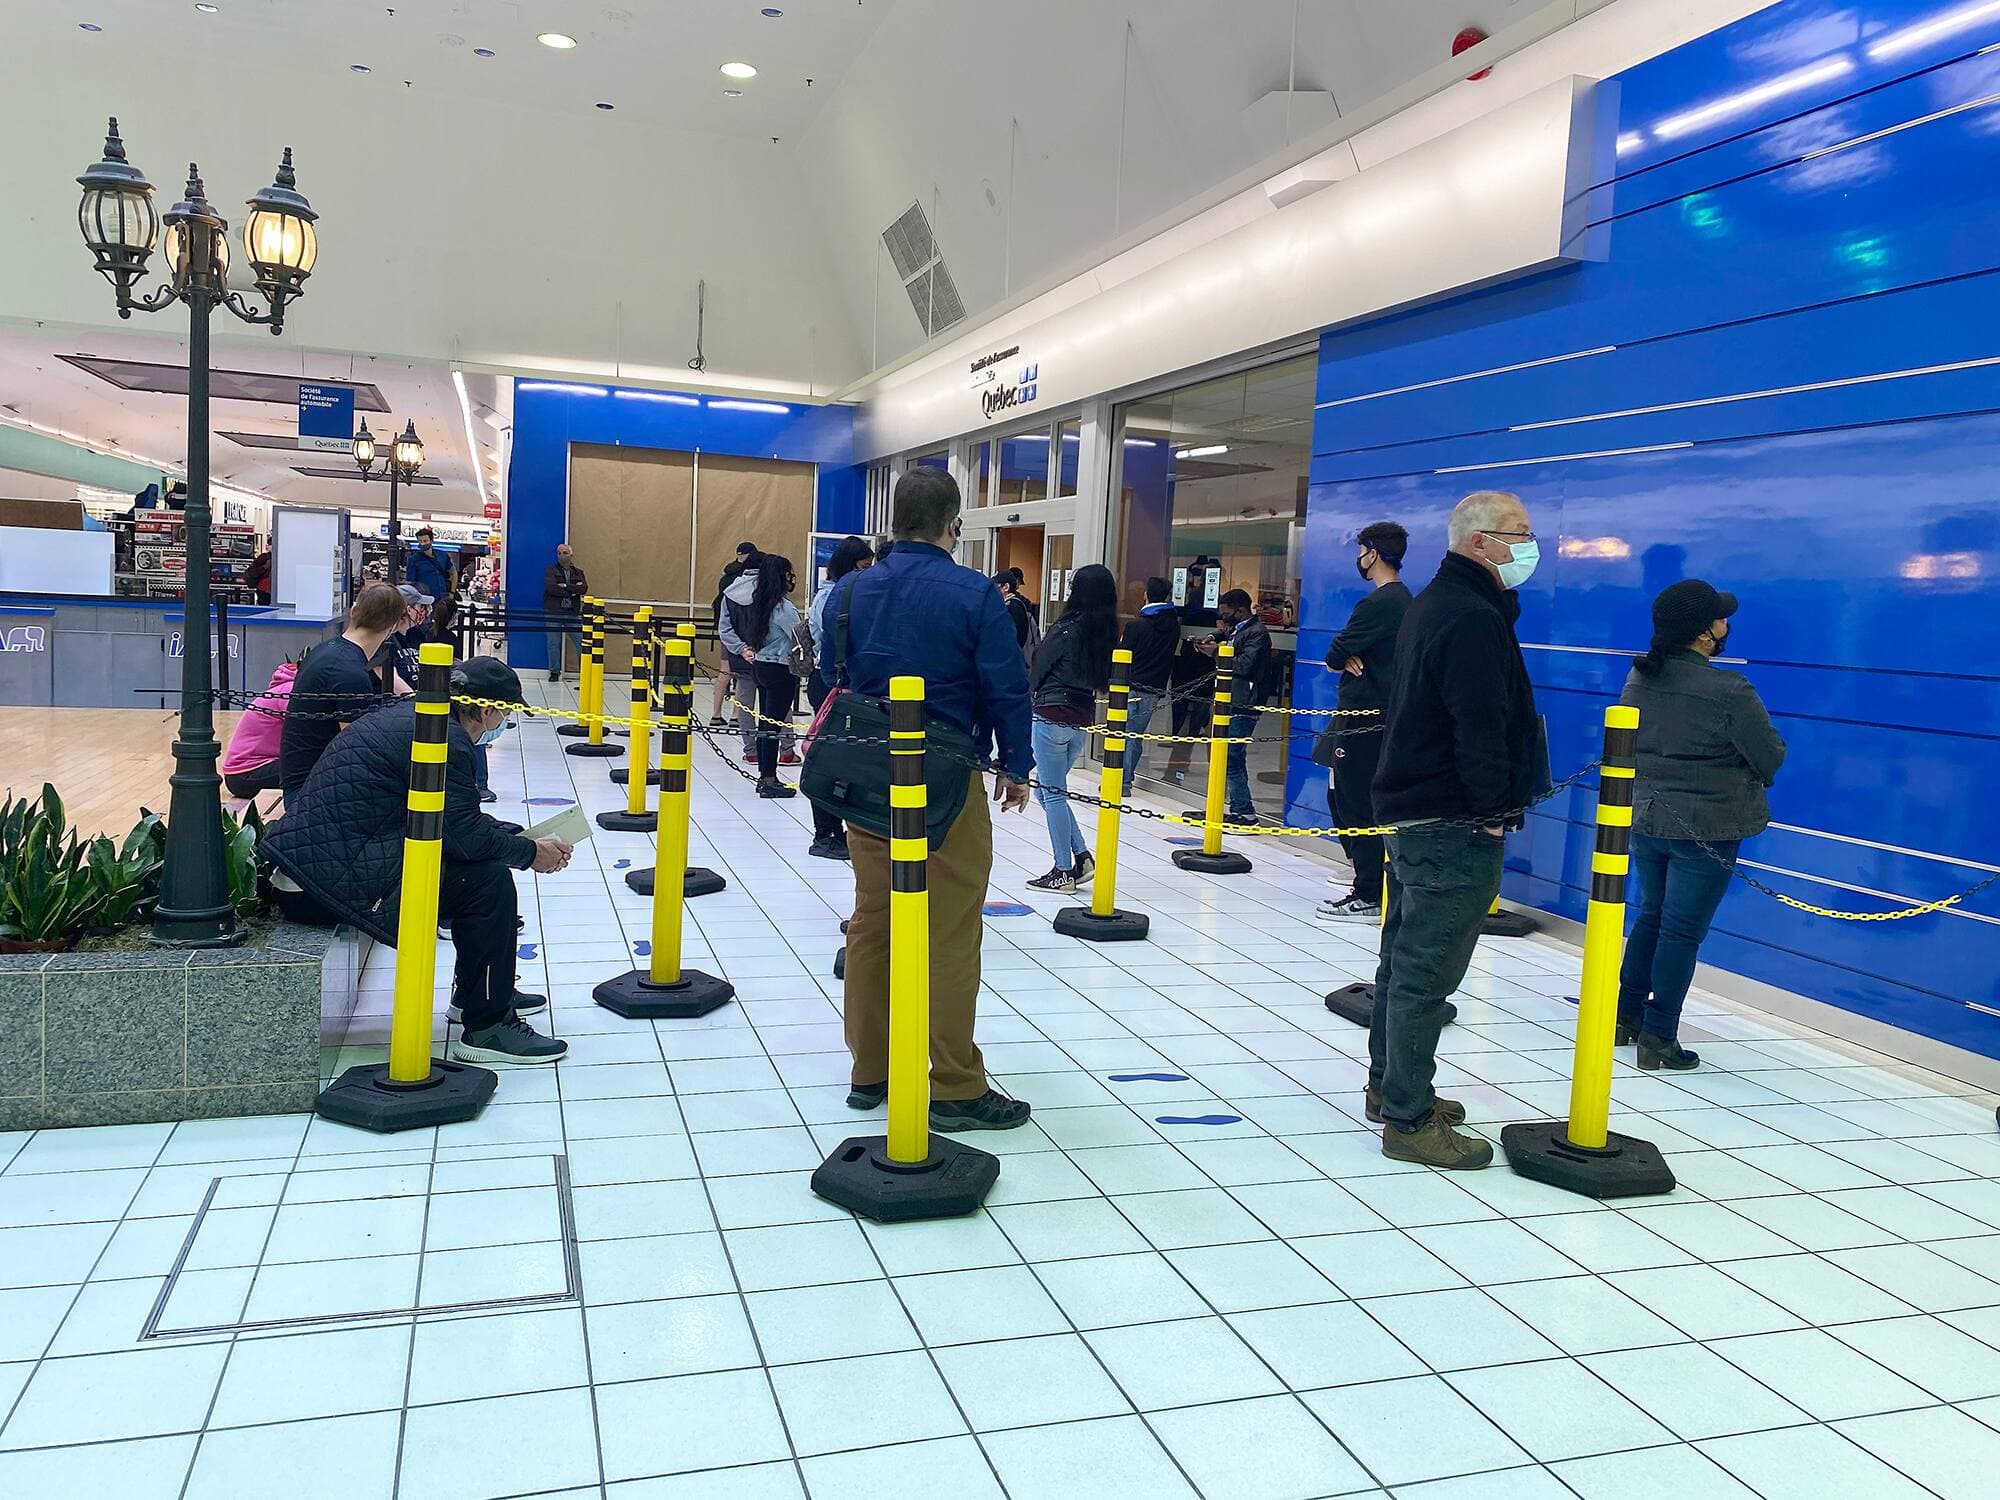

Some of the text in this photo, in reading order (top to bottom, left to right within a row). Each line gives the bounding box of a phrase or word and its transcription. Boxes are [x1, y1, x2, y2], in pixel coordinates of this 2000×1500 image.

[301, 386, 321, 394] Société
[982, 383, 1018, 419] Québec
[315, 440, 339, 448] Québec
